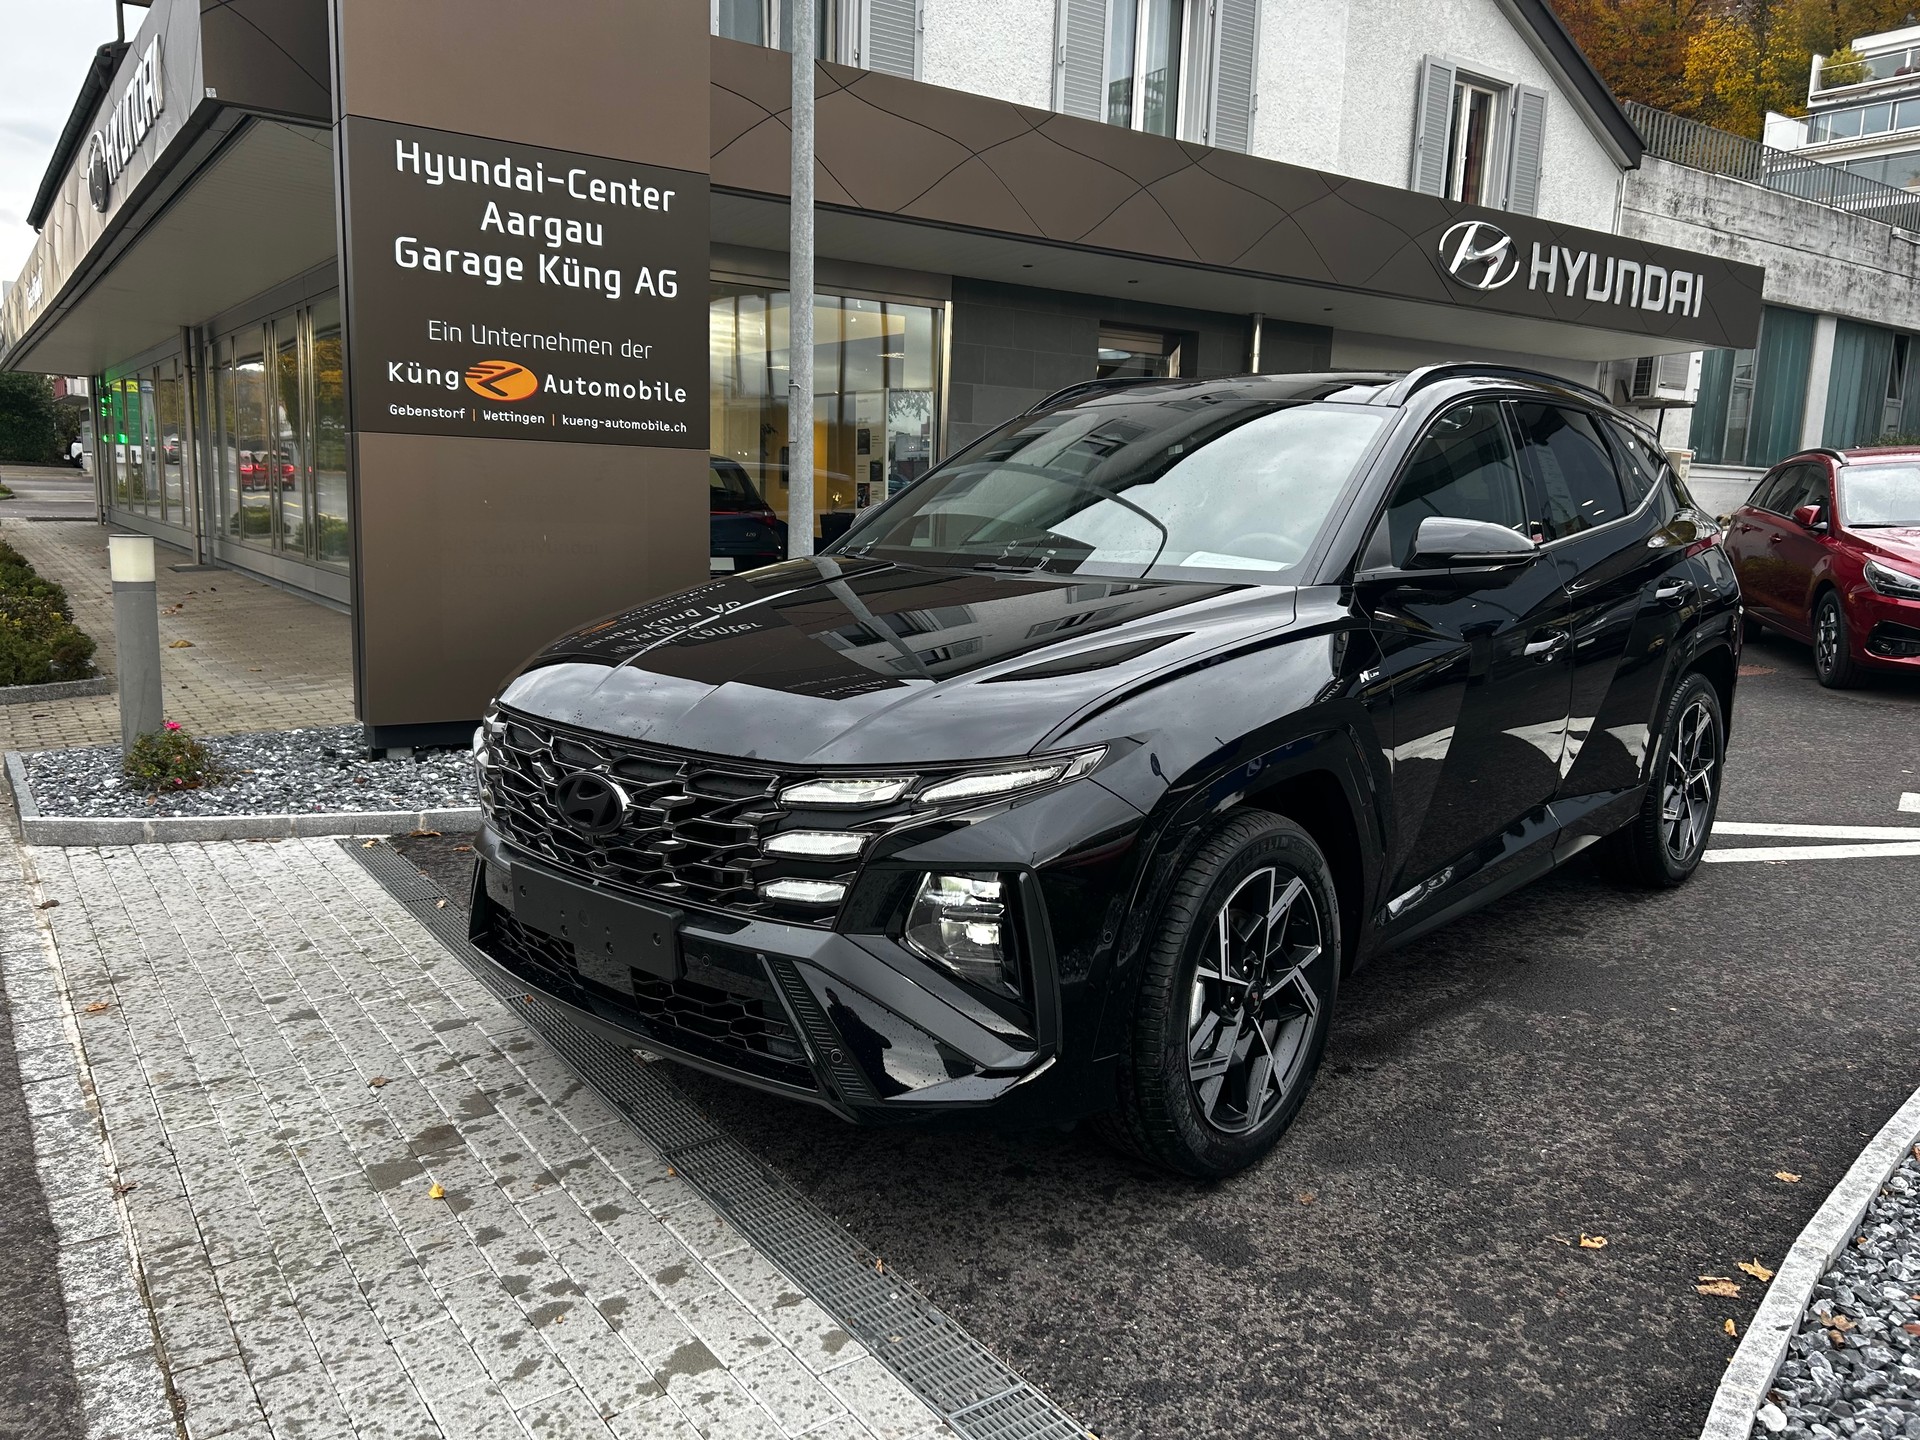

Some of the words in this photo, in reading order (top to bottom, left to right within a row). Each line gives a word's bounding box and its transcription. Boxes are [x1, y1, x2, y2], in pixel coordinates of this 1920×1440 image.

[395, 139, 676, 212] Hyundai-Center
[480, 201, 603, 248] Aargau
[395, 236, 524, 286] Garage
[539, 253, 621, 299] Küng
[634, 267, 678, 299] AG
[1528, 241, 1704, 318] HYUNDAI
[428, 320, 462, 343] Ein
[471, 323, 613, 356] Unternehmen
[620, 338, 653, 359] der
[388, 361, 460, 391] Küng
[543, 373, 688, 403] Automobile
[389, 404, 466, 420] Gebenstorf
[483, 410, 546, 425] Wettingen
[562, 414, 688, 433] kueng-automobile.ch
